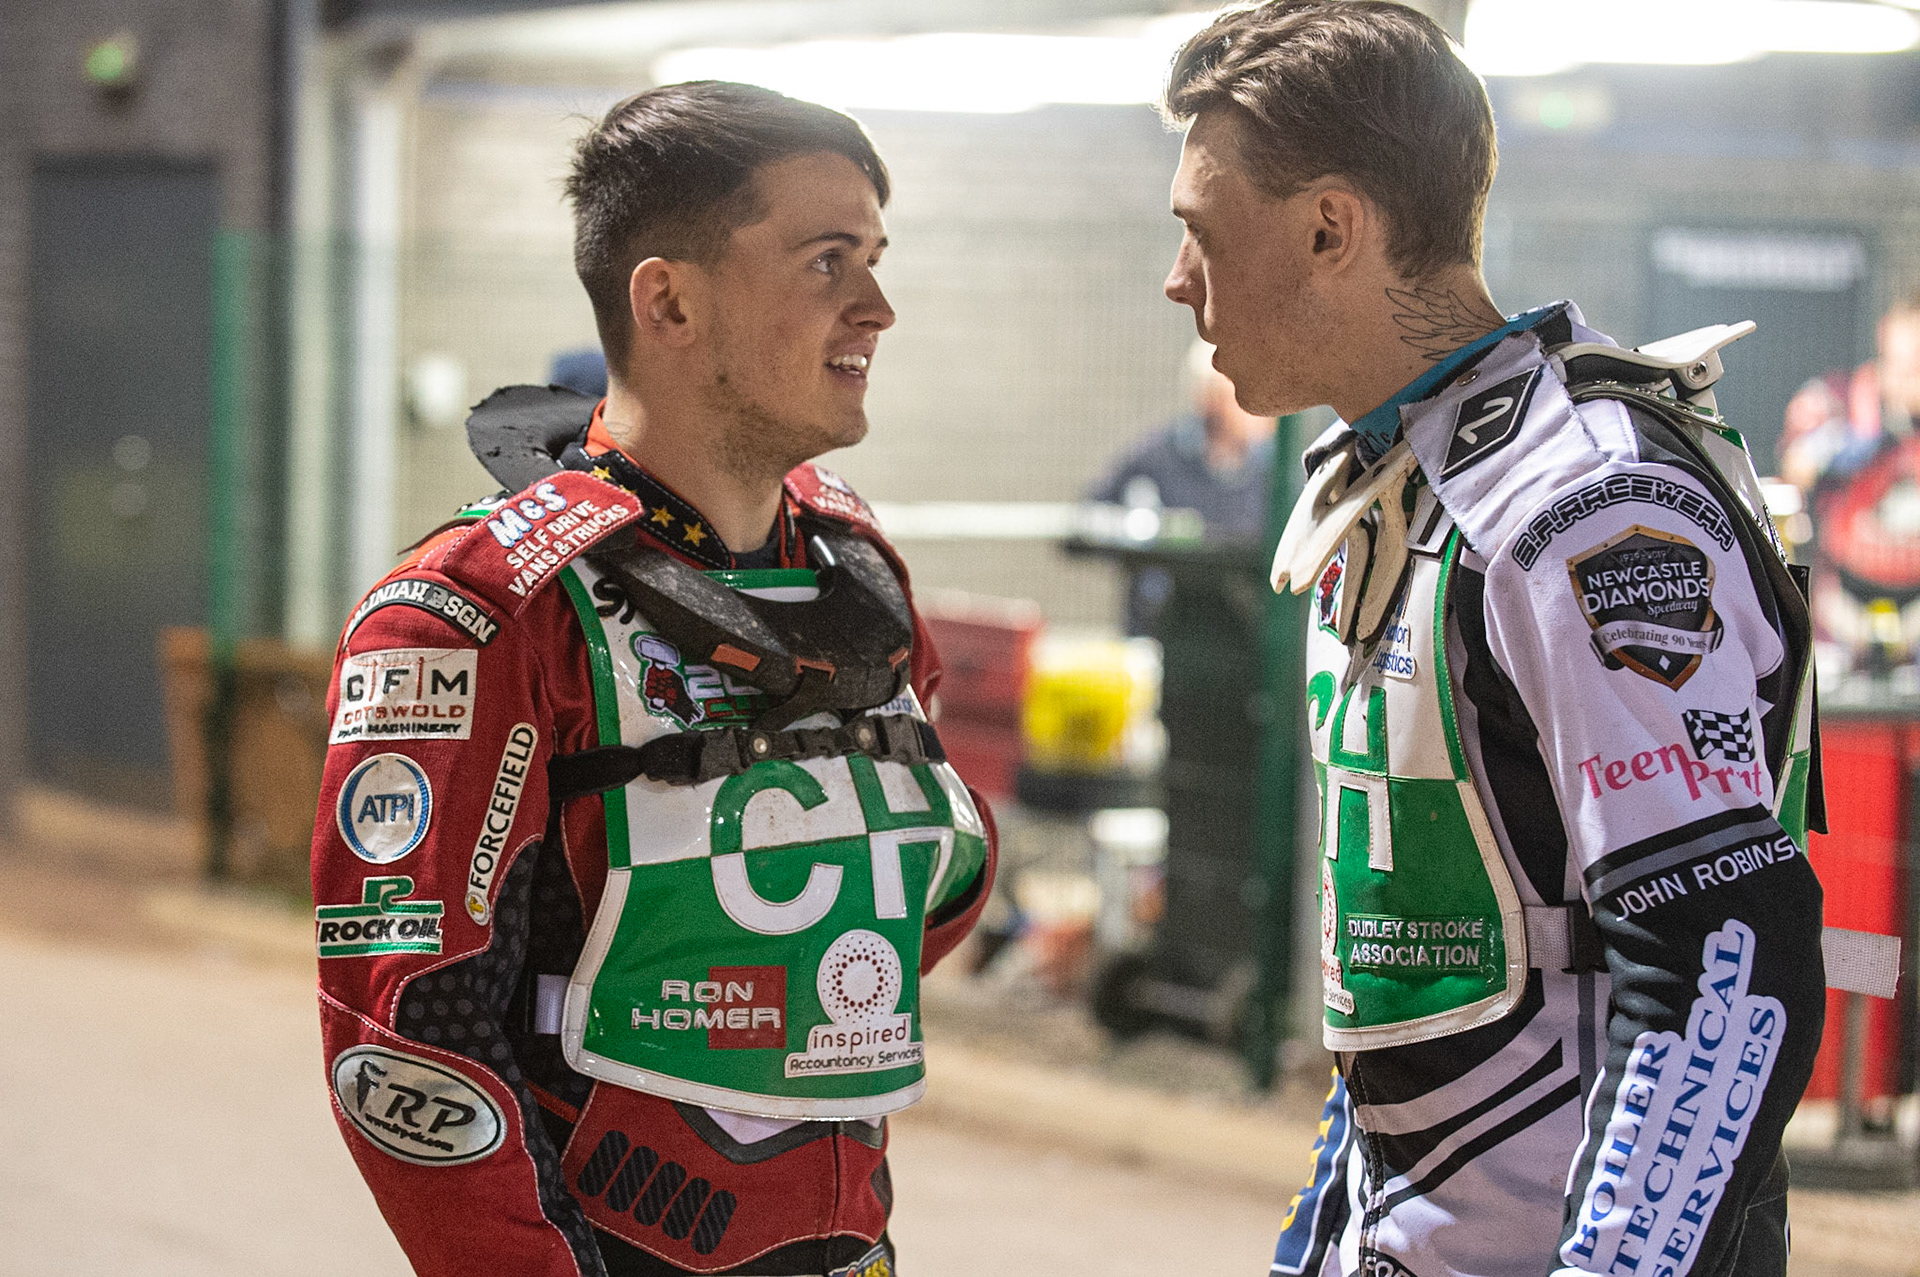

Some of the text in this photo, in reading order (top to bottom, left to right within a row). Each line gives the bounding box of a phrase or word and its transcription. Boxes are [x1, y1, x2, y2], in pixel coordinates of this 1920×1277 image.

[506, 499, 601, 570] SELF DRIVE
[508, 548, 560, 598] VANS
[567, 504, 630, 554] TRUCKS
[1587, 561, 1702, 591] NEWCASTLE
[1583, 577, 1711, 615] DIAMONDS
[1647, 600, 1699, 618] Speedway
[1602, 628, 1669, 646] Celebrating
[1672, 634, 1686, 646] 90
[343, 704, 467, 725] COTSWOLD
[367, 722, 462, 734] MACHINERY
[470, 727, 534, 890] FORCEFIELD
[1615, 835, 1803, 922] JOHN ROBINS
[320, 919, 443, 943] ROCK OIL
[1348, 918, 1484, 940] DUDLEY STROKE
[1350, 943, 1480, 967] ASSOCIATION
[661, 979, 755, 1003] RON
[631, 1007, 782, 1031] HOMER
[813, 1021, 907, 1054] inspired
[790, 1047, 923, 1071] Accountancy Services
[1609, 930, 1745, 1276] TECHNICAL
[1570, 1042, 1671, 1264] BOILER
[1653, 1006, 1776, 1277] SERVICES
